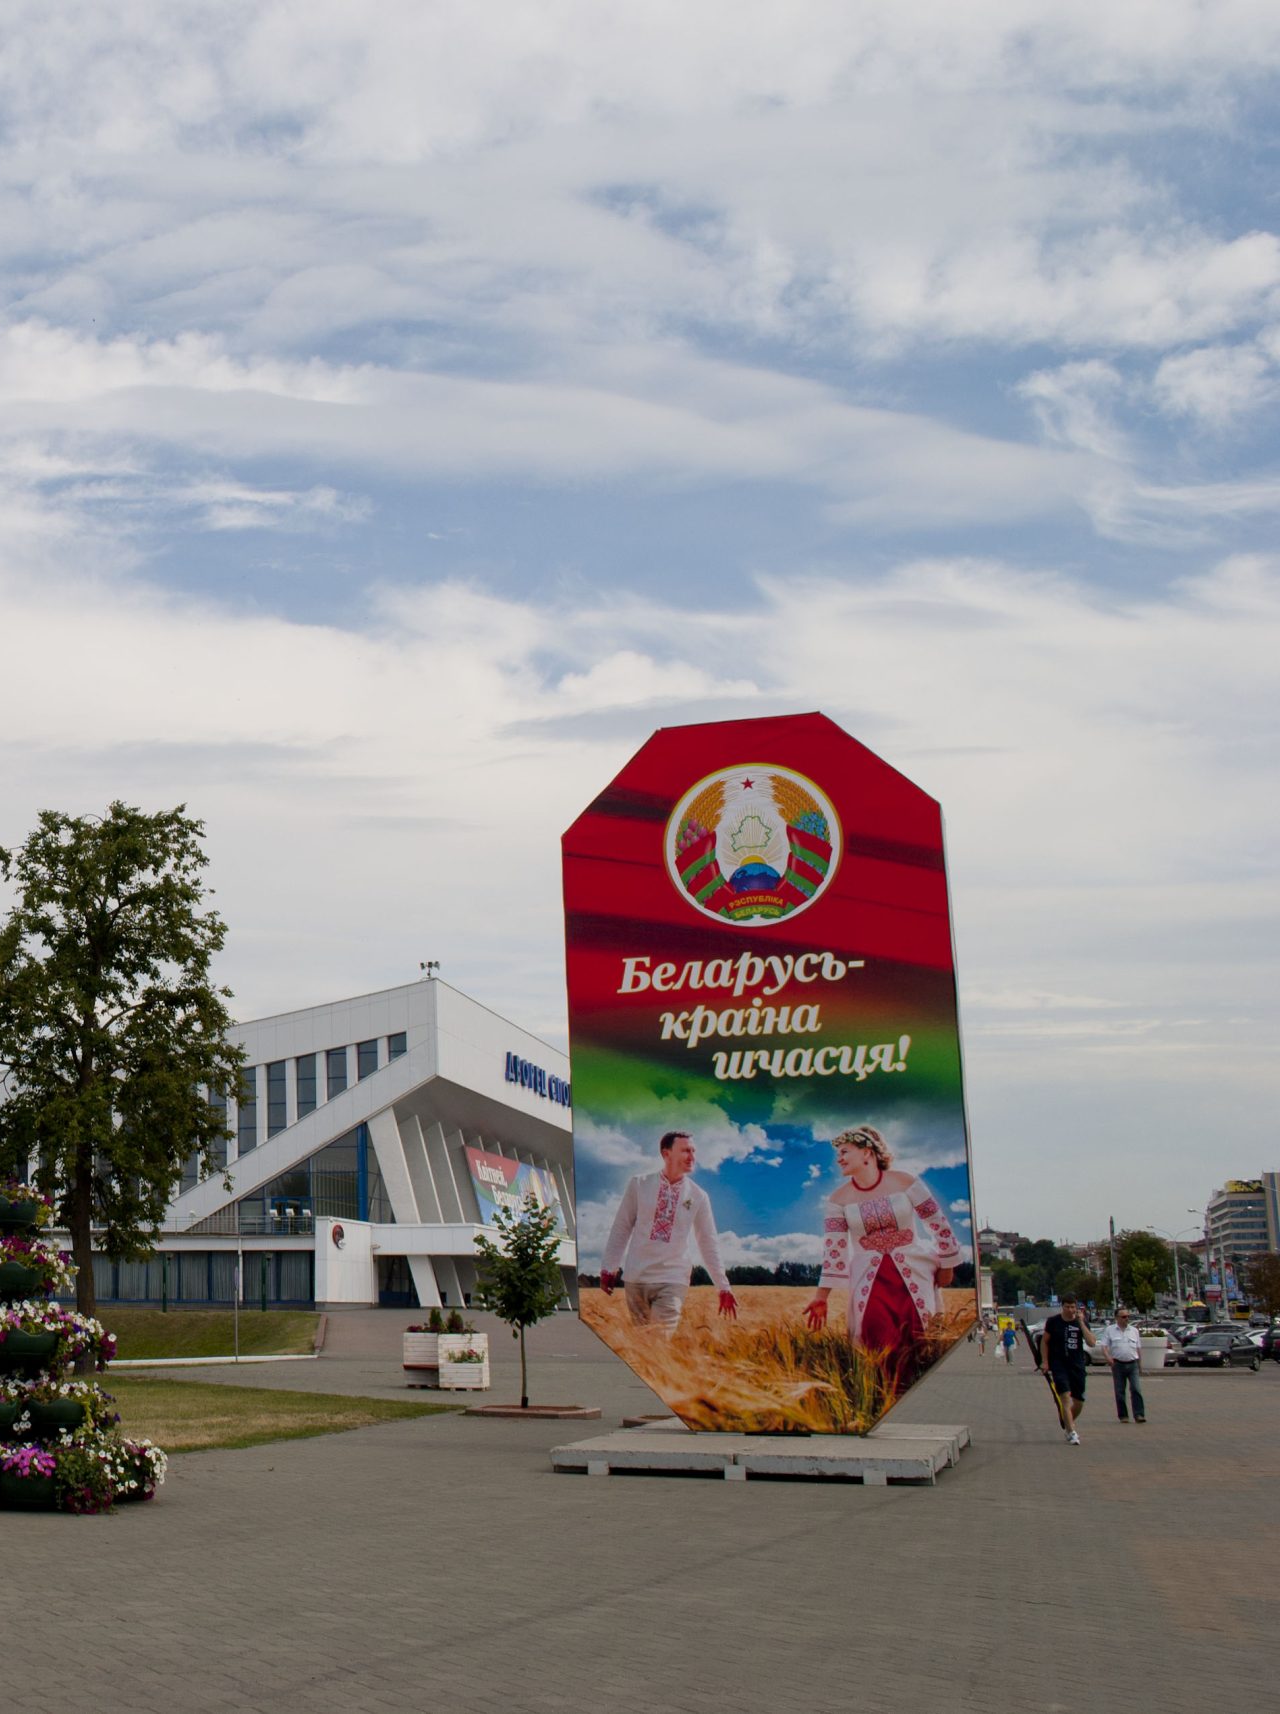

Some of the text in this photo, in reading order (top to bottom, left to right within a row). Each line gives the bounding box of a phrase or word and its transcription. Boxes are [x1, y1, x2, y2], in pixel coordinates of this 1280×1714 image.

[616, 951, 865, 997] Беларусь-
[659, 997, 822, 1049] краіна
[505, 1051, 547, 1098] ДВОРЕЦ
[711, 1034, 911, 1082] шчасця!
